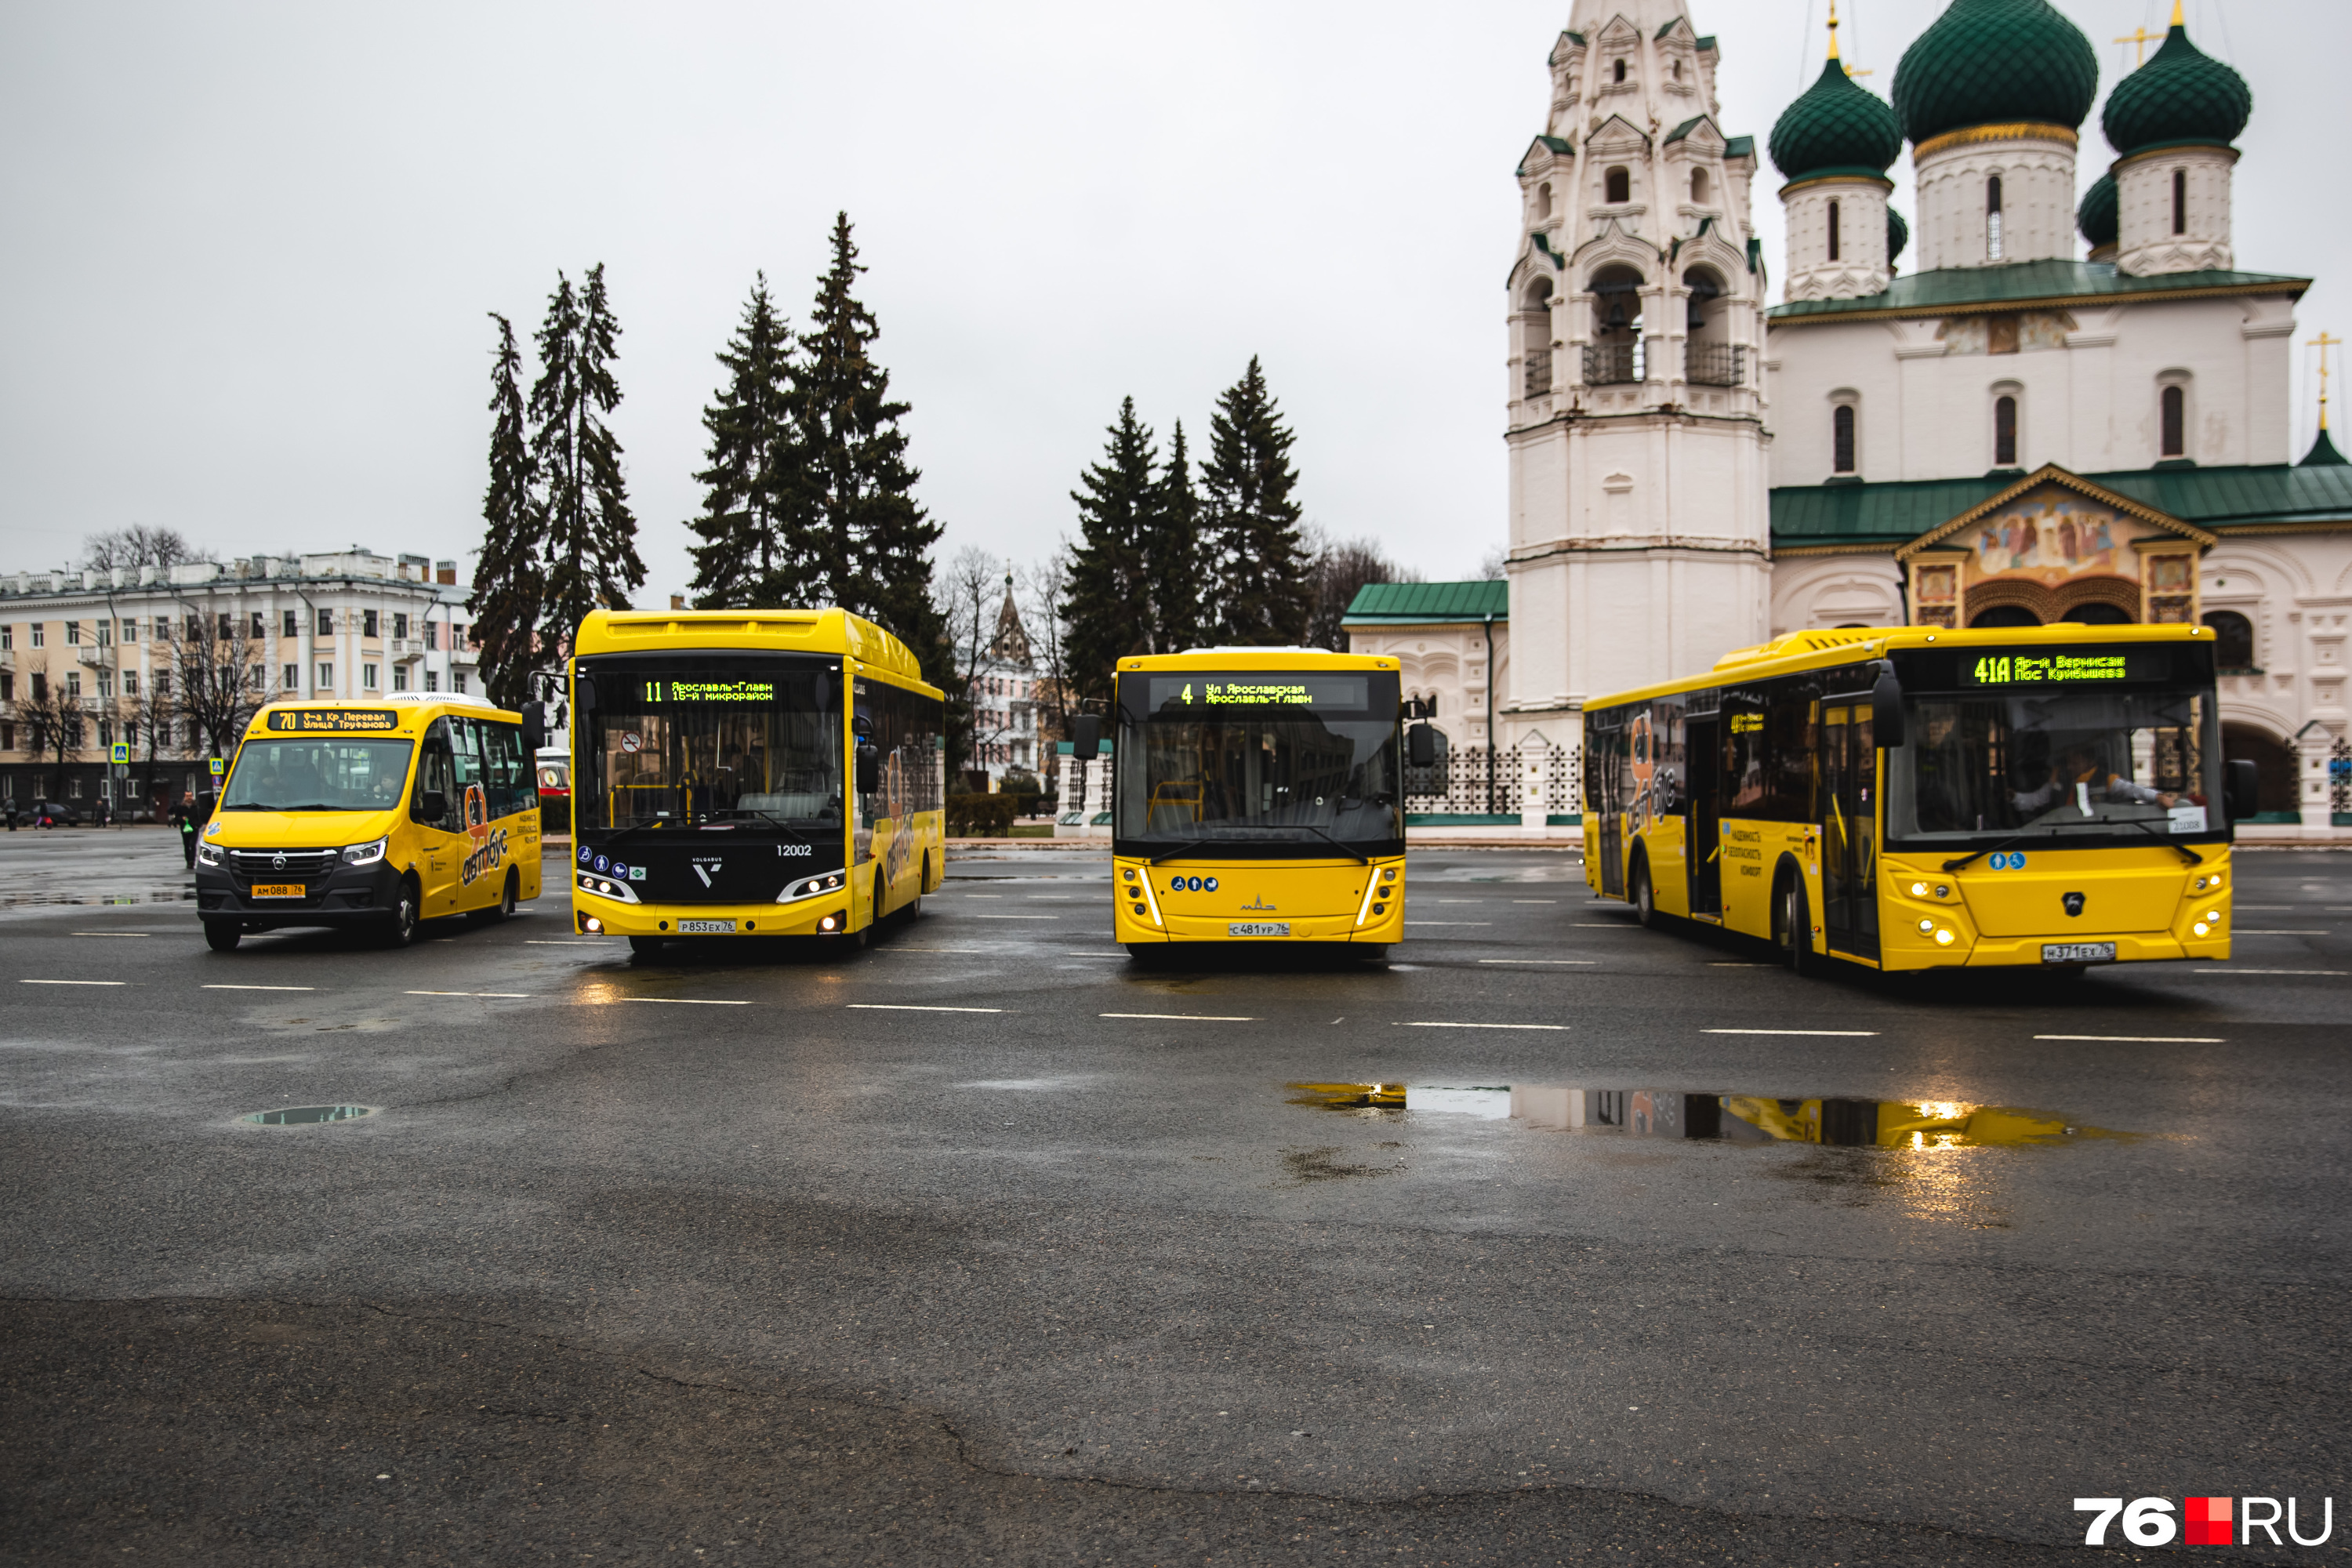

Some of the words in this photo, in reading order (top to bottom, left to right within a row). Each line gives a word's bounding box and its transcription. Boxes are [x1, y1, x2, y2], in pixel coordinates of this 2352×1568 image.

[1974, 657, 2010, 683] 41А
[2014, 669, 2042, 681] Пос
[646, 681, 662, 702] 11
[672, 681, 773, 691] Ярославль-Главн
[1206, 684, 1221, 695] Ул
[1227, 684, 1305, 695] Ярославская
[705, 691, 773, 702] микрорайон
[1181, 684, 1193, 705] 4
[1206, 694, 1312, 705] Ярославль-Главн
[279, 712, 296, 730] 70
[326, 712, 339, 722] Кр
[344, 712, 386, 721] Перевал
[303, 720, 333, 730] Улица
[339, 720, 391, 730] Труфанова
[777, 844, 812, 856] 12002
[723, 921, 733, 930] 76
